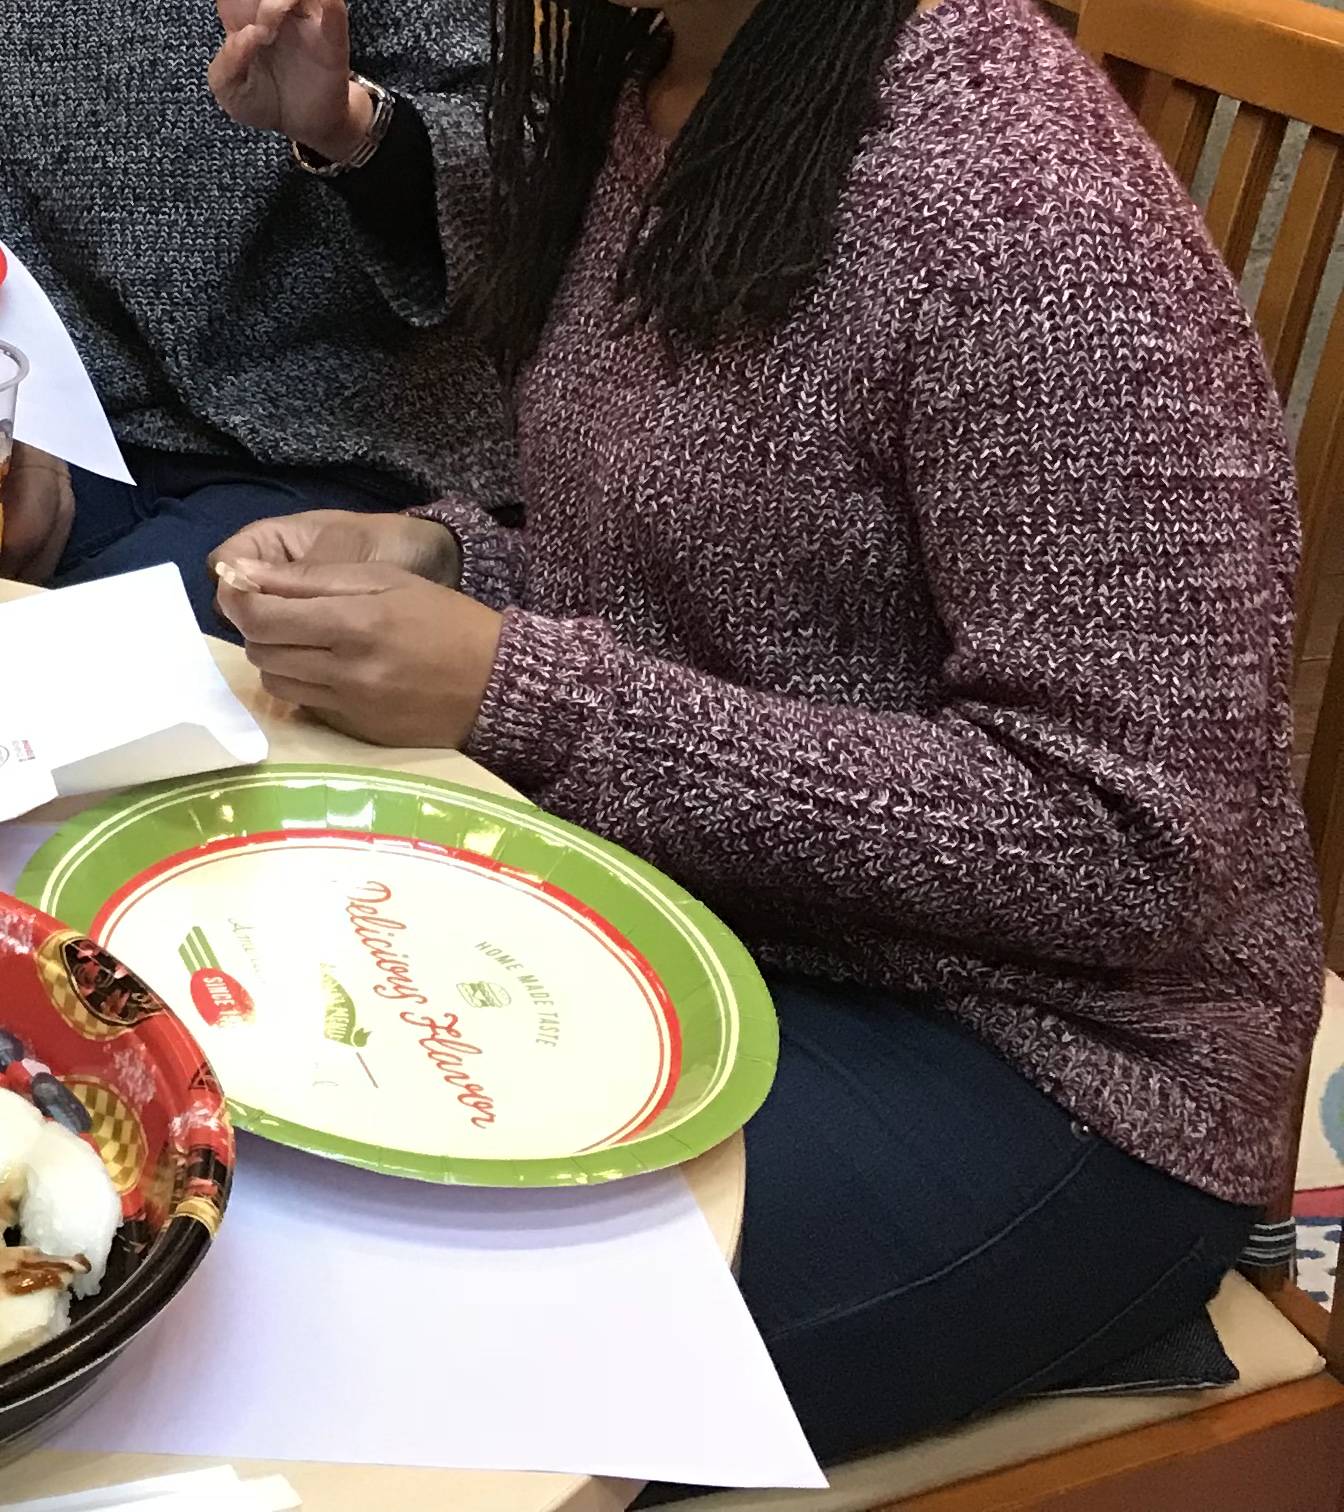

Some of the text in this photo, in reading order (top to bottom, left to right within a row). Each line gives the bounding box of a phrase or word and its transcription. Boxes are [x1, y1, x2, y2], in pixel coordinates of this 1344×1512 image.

[203, 976, 236, 1006] SINCE
[345, 880, 497, 1130] Delicious Flavor
[474, 941, 560, 1048] HOME MADE TASTE
